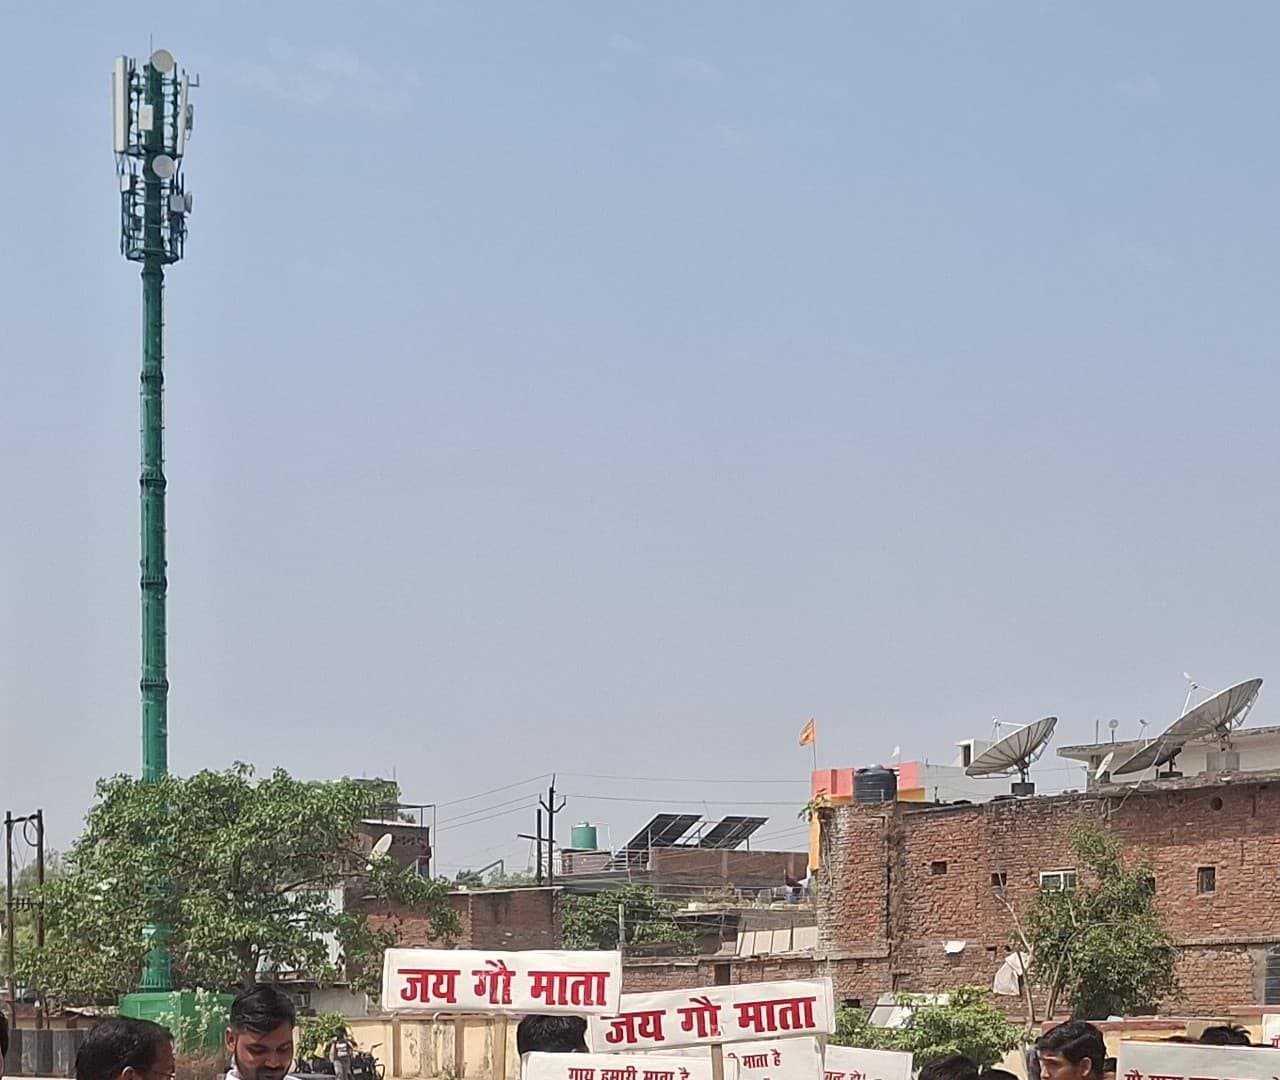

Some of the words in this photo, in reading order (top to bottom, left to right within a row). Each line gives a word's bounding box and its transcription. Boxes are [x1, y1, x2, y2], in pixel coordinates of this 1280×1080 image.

[398, 968, 461, 1004] जय
[472, 959, 517, 1004] गौ
[528, 971, 610, 1006] माता
[600, 1010, 666, 1044] जय
[677, 996, 721, 1037] गौ
[734, 997, 816, 1033] माता
[742, 1052, 769, 1069] माता
[771, 1049, 781, 1067] है
